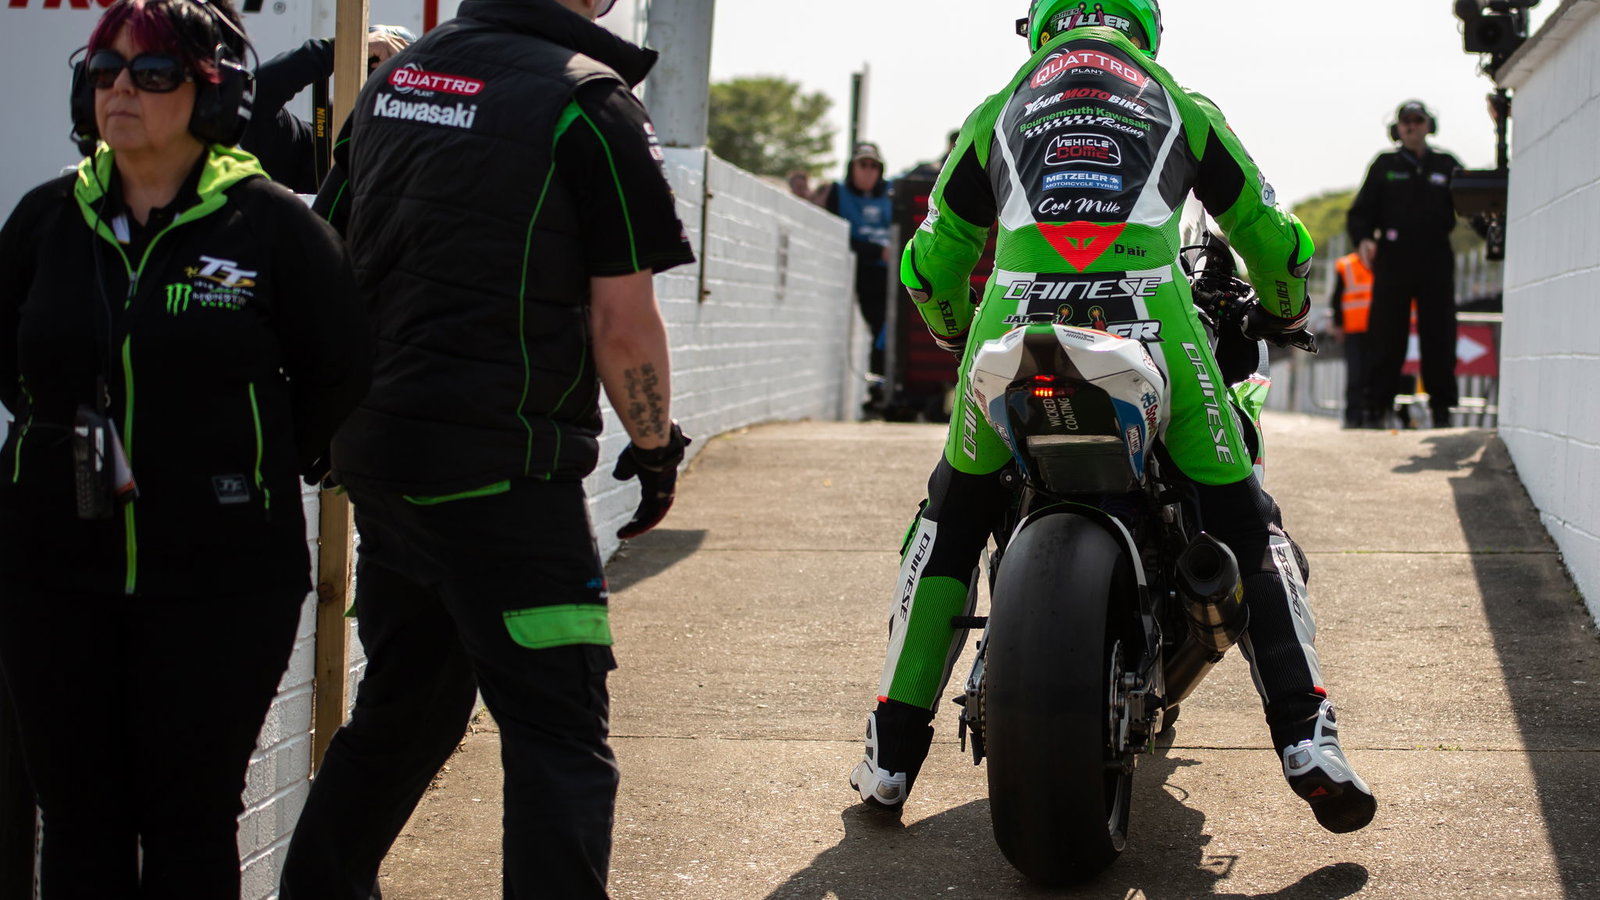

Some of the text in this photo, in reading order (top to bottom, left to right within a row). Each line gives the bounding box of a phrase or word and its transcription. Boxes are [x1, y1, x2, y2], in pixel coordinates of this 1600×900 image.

[392, 69, 480, 94] QUATTRO
[1037, 53, 1138, 83] QUATTRO
[314, 107, 324, 138] Nikon
[373, 93, 477, 129] Kawasaki
[1020, 106, 1152, 133] Bournemouth Kawasaki
[1101, 117, 1146, 138] Racing
[1045, 181, 1093, 189] MOTORCYCLE
[1046, 173, 1108, 183] METZELER
[1038, 197, 1121, 215] Cool Milk
[200, 255, 257, 288] TT
[1002, 277, 1162, 300] DAINESE
[1043, 399, 1060, 427] WICKED
[1057, 397, 1079, 431] COATING
[1181, 342, 1235, 464] DAINESE
[900, 532, 931, 622] DAINESE
[1274, 545, 1302, 619] DAINESE
